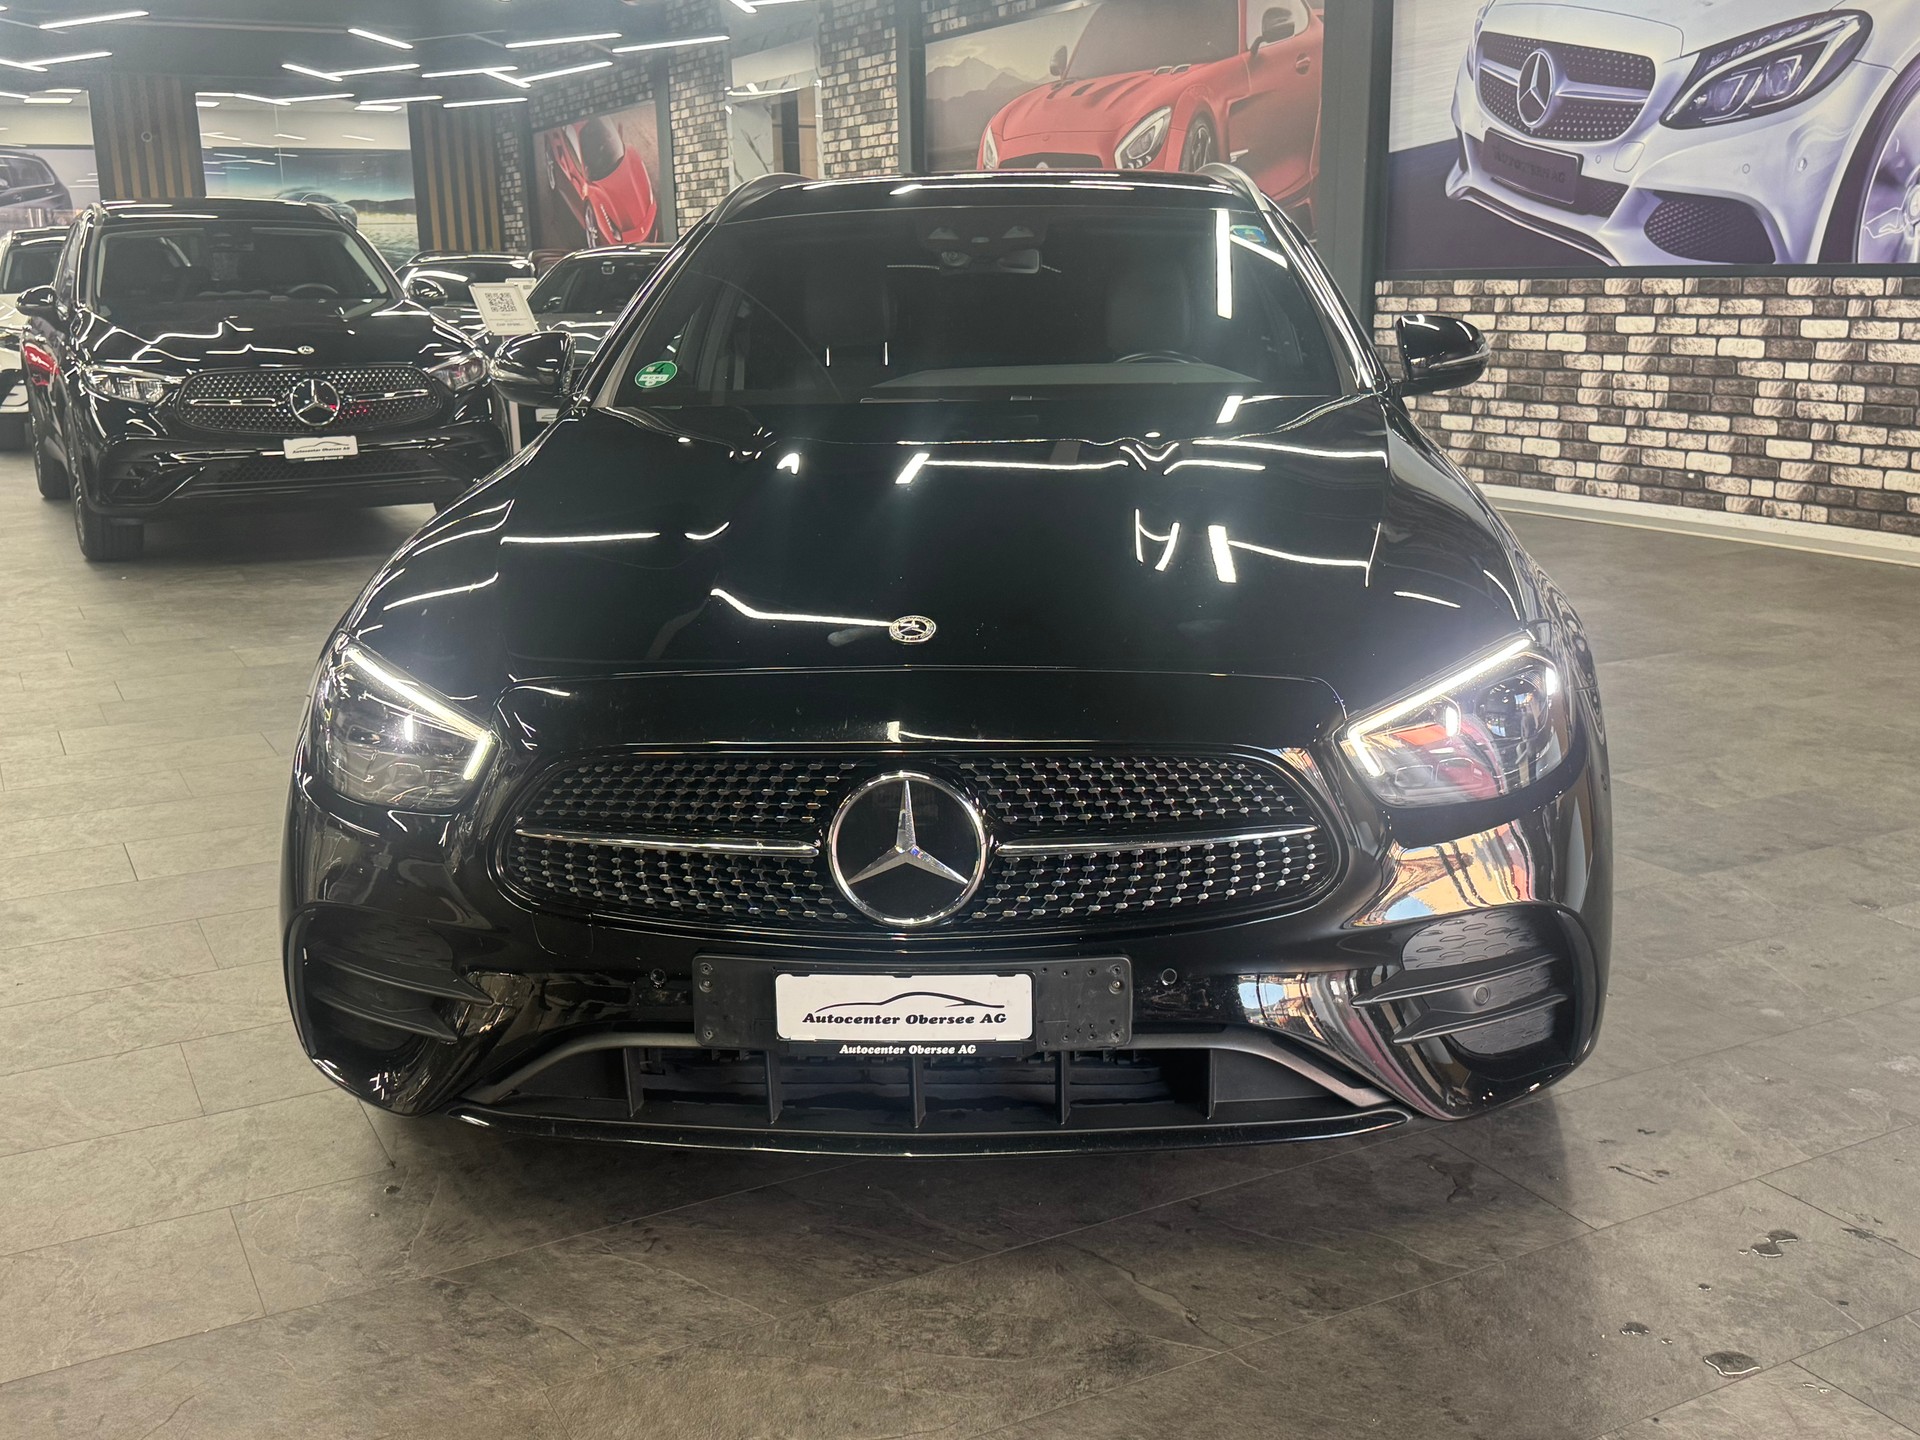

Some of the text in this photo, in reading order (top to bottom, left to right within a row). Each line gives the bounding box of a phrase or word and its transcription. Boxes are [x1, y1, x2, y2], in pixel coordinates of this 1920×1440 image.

[802, 1012, 1007, 1025] Autocenter Obersee AG
[839, 1044, 977, 1055] Autocenter Obersee AG
